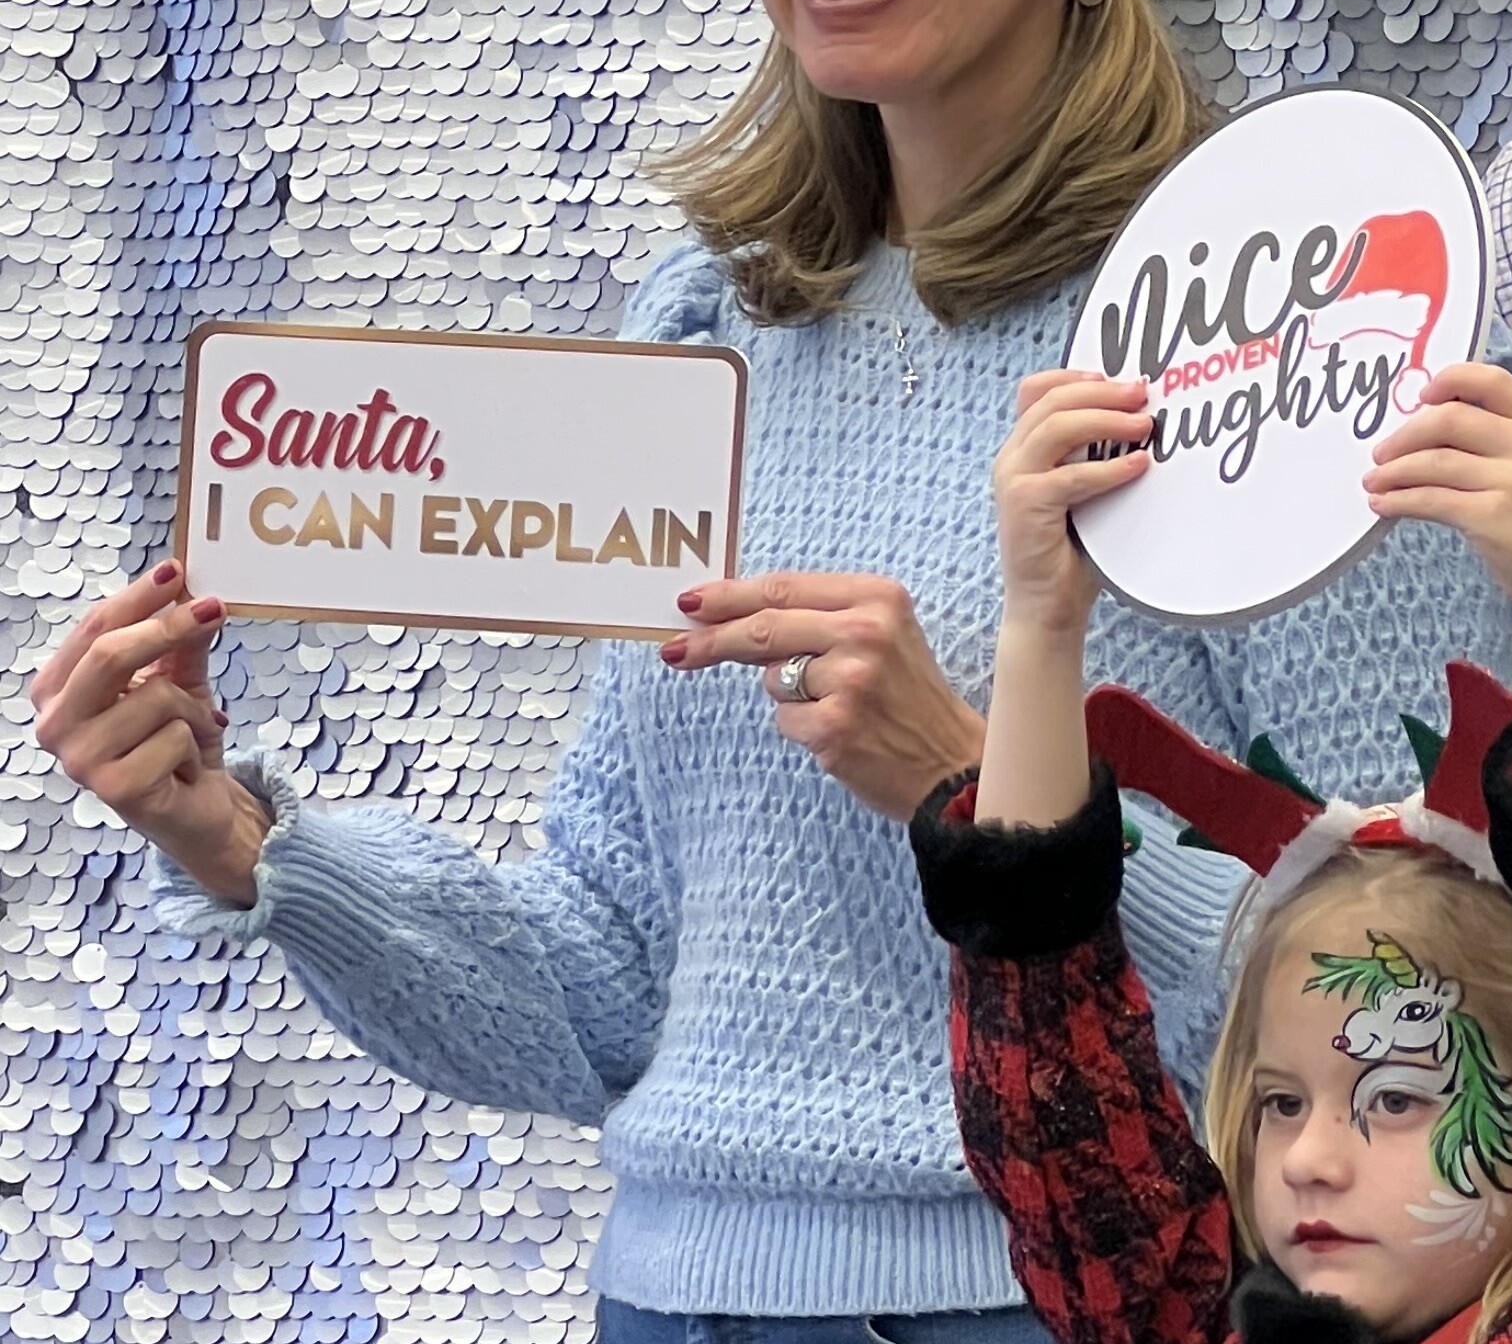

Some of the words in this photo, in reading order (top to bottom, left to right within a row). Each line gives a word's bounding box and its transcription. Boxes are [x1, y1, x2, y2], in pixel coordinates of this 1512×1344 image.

[1163, 332, 1281, 398] PROVEN
[210, 372, 446, 482] Santa,
[206, 483, 222, 541] I
[249, 486, 395, 550] CAN
[420, 494, 712, 568] EXPLAIN
